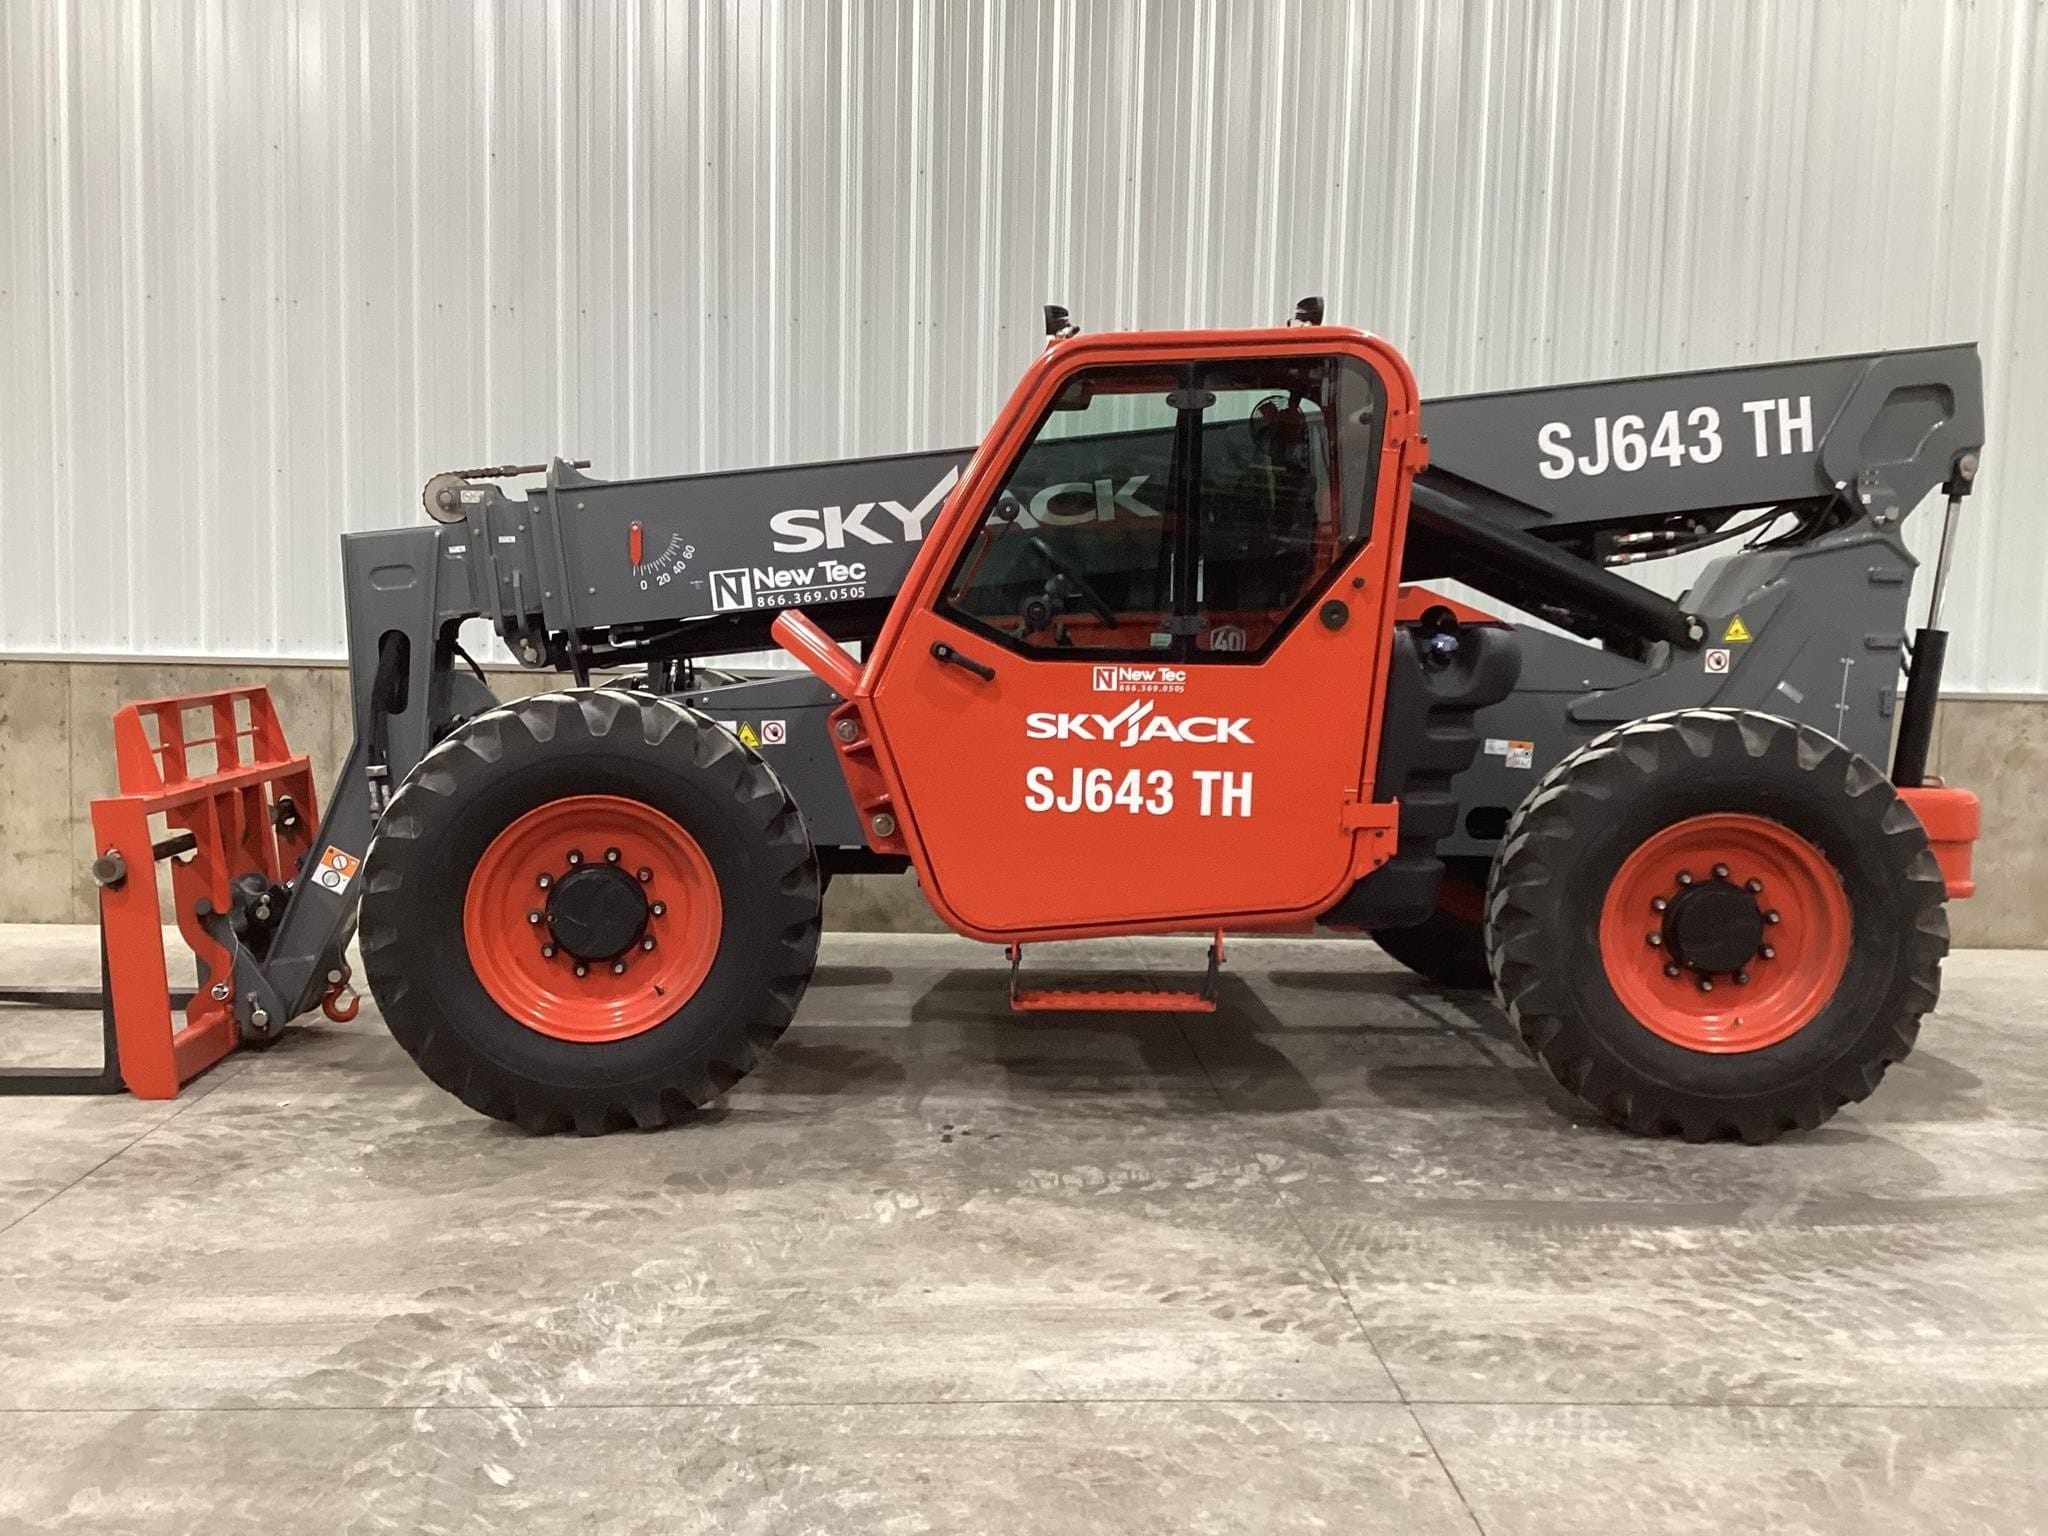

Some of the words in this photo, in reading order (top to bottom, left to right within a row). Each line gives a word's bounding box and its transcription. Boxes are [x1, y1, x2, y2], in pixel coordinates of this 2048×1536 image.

[1538, 406, 1722, 480] SJ643
[1743, 395, 1815, 458] TH
[656, 572, 671, 586] 20
[672, 560, 686, 575] 40
[682, 544, 696, 560] 60
[754, 566, 815, 589] New
[818, 560, 867, 583] Tec
[757, 587, 866, 607] 866.369.0505
[1119, 667, 1156, 682] New
[1158, 668, 1186, 682] Tec
[1026, 699, 1254, 747] SKYJACK
[1025, 767, 1174, 815] SJ643
[1192, 771, 1253, 817] TH
